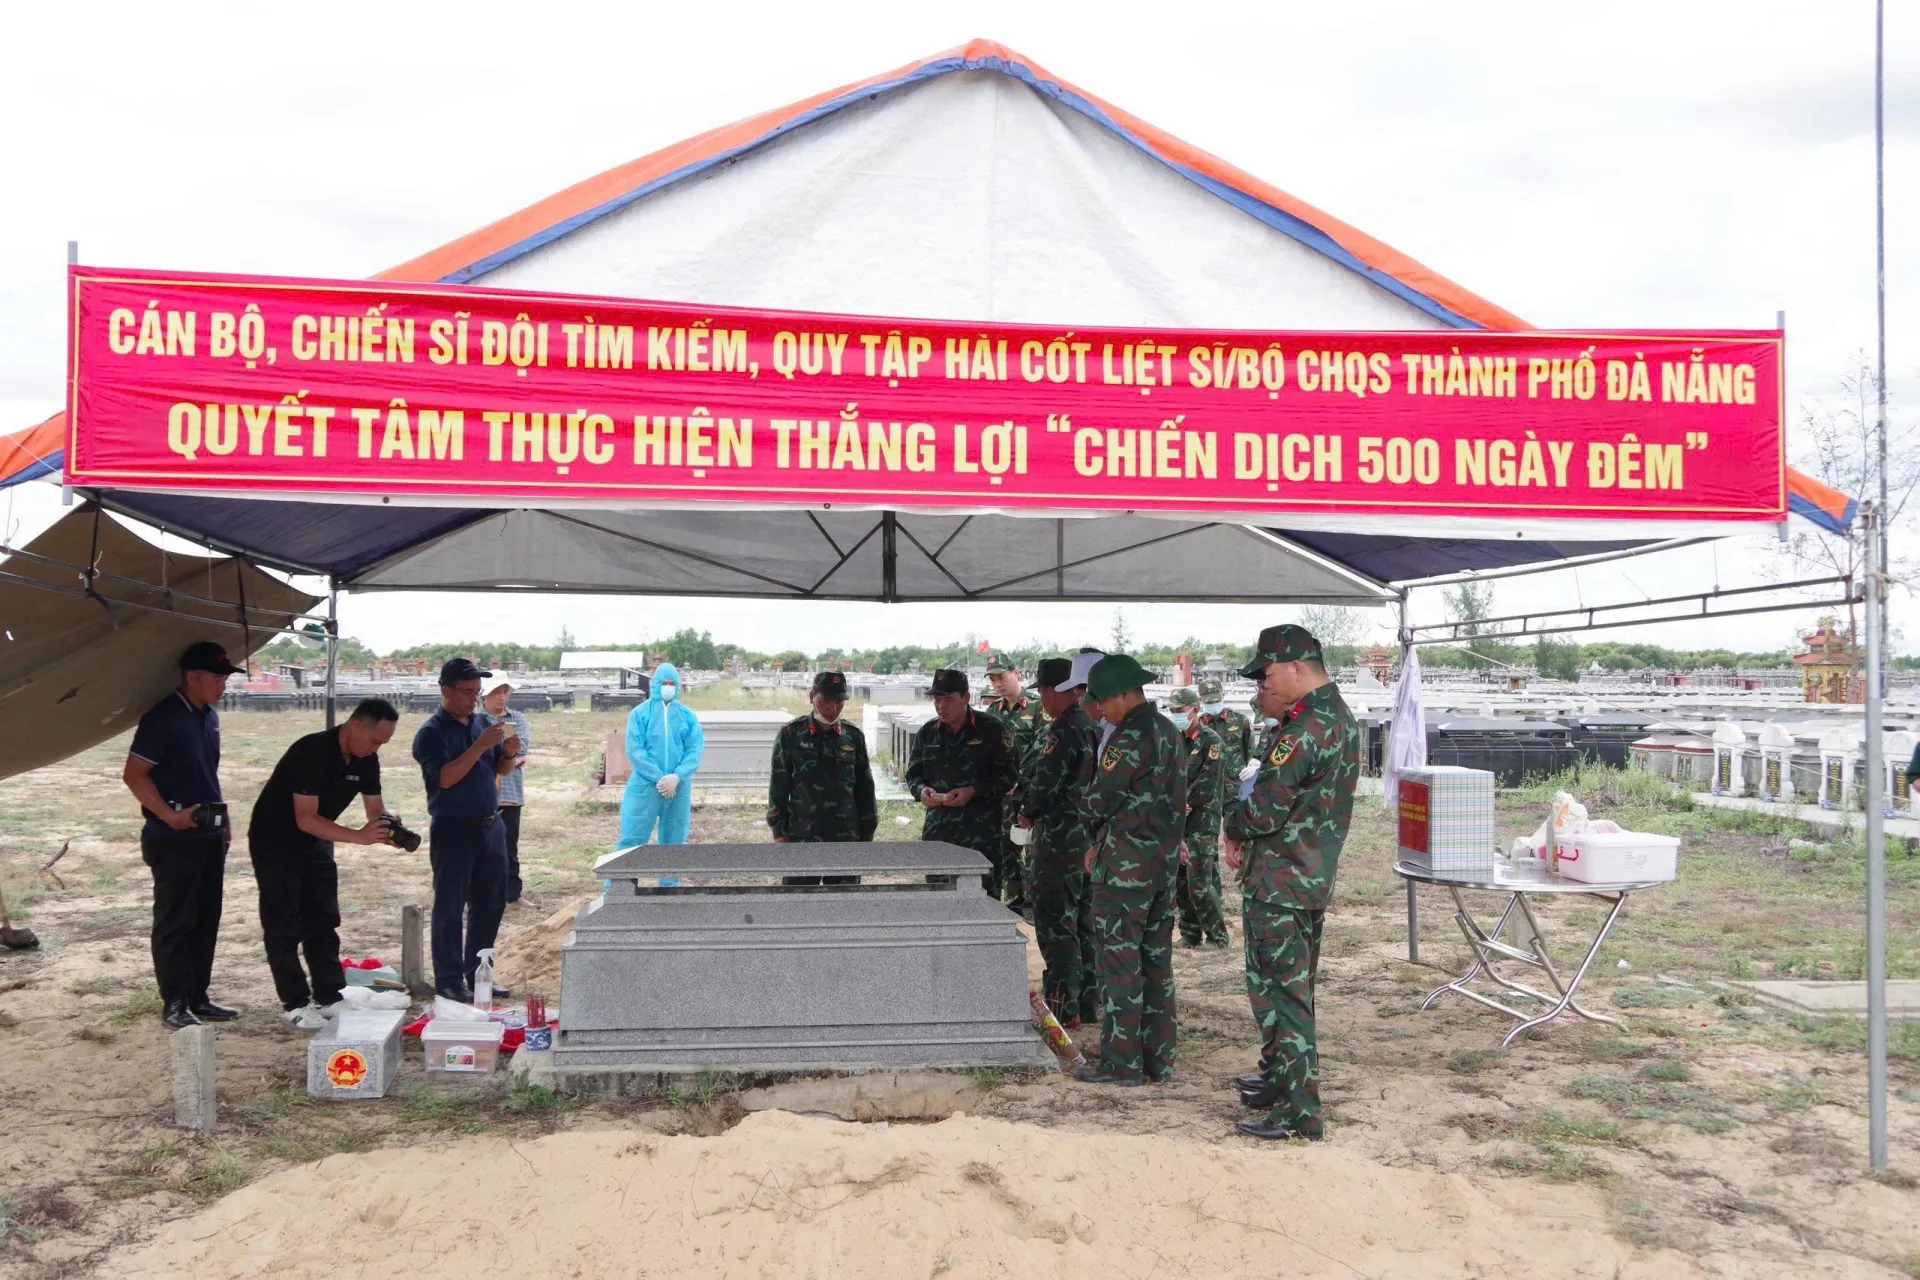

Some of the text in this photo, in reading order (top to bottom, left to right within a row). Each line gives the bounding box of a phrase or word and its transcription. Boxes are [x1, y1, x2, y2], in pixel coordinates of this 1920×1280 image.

[109, 300, 1756, 405] CÁN BỘ, CHIẾN SĨ ĐỘI TÌM KIẾM, QUY TẬP HÀI CỐT LIỆT SĨ/BỘ CHQS THÀNH PHỐ ĐÀ NẴNG
[167, 389, 336, 461] QUYẾT
[351, 398, 465, 460] TÂM
[482, 408, 615, 475] THỰC
[634, 406, 754, 478] HIỆN
[770, 402, 936, 473] THẮNG
[954, 420, 1028, 485] LỢI
[1234, 433, 1343, 492] DỊCH
[1357, 436, 1440, 485] 500
[1455, 430, 1574, 488] NGÀY
